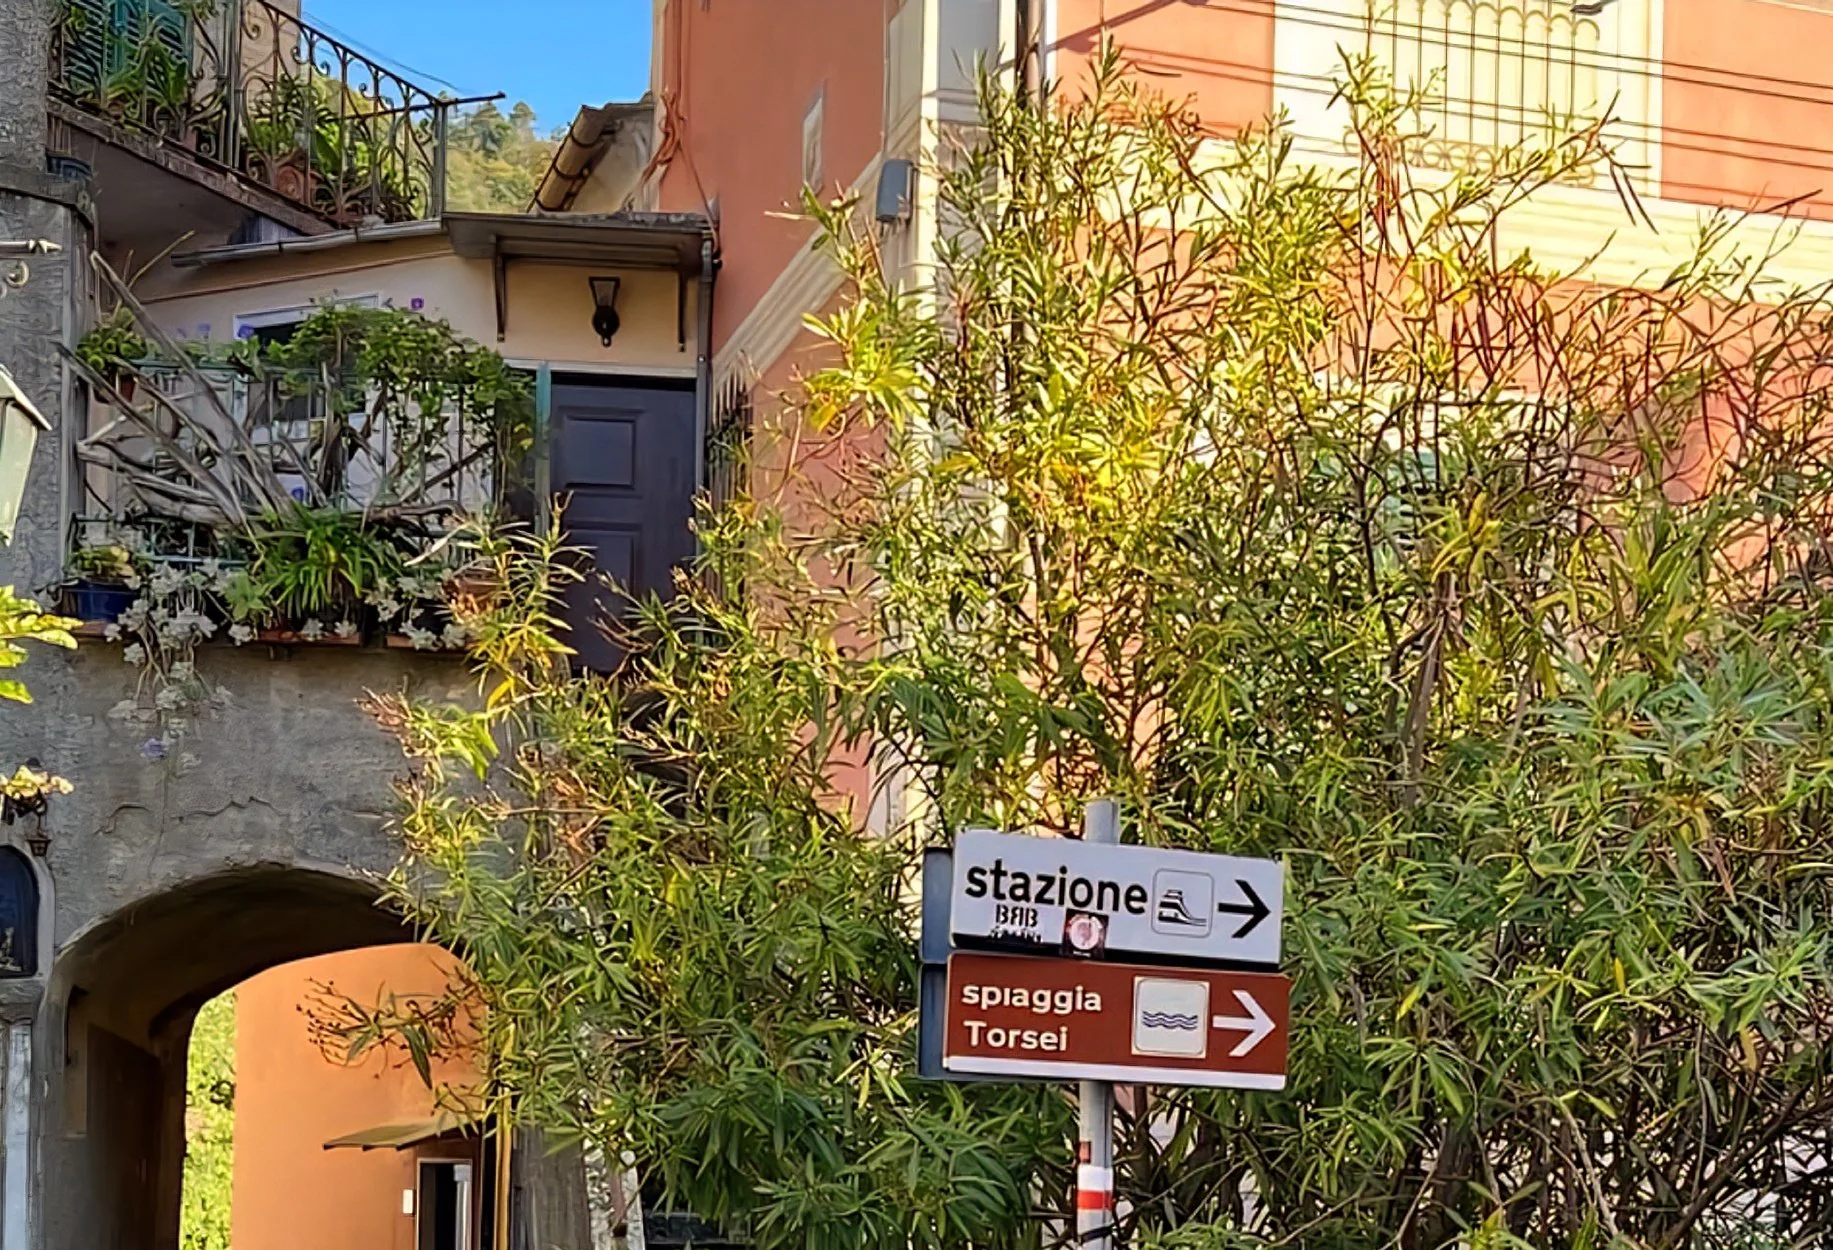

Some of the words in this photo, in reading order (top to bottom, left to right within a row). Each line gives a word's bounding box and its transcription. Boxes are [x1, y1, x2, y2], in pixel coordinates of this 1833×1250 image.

[965, 858, 1148, 914] stazione
[962, 985, 1102, 1014] spiaggia
[963, 1020, 1068, 1052] Torsei
